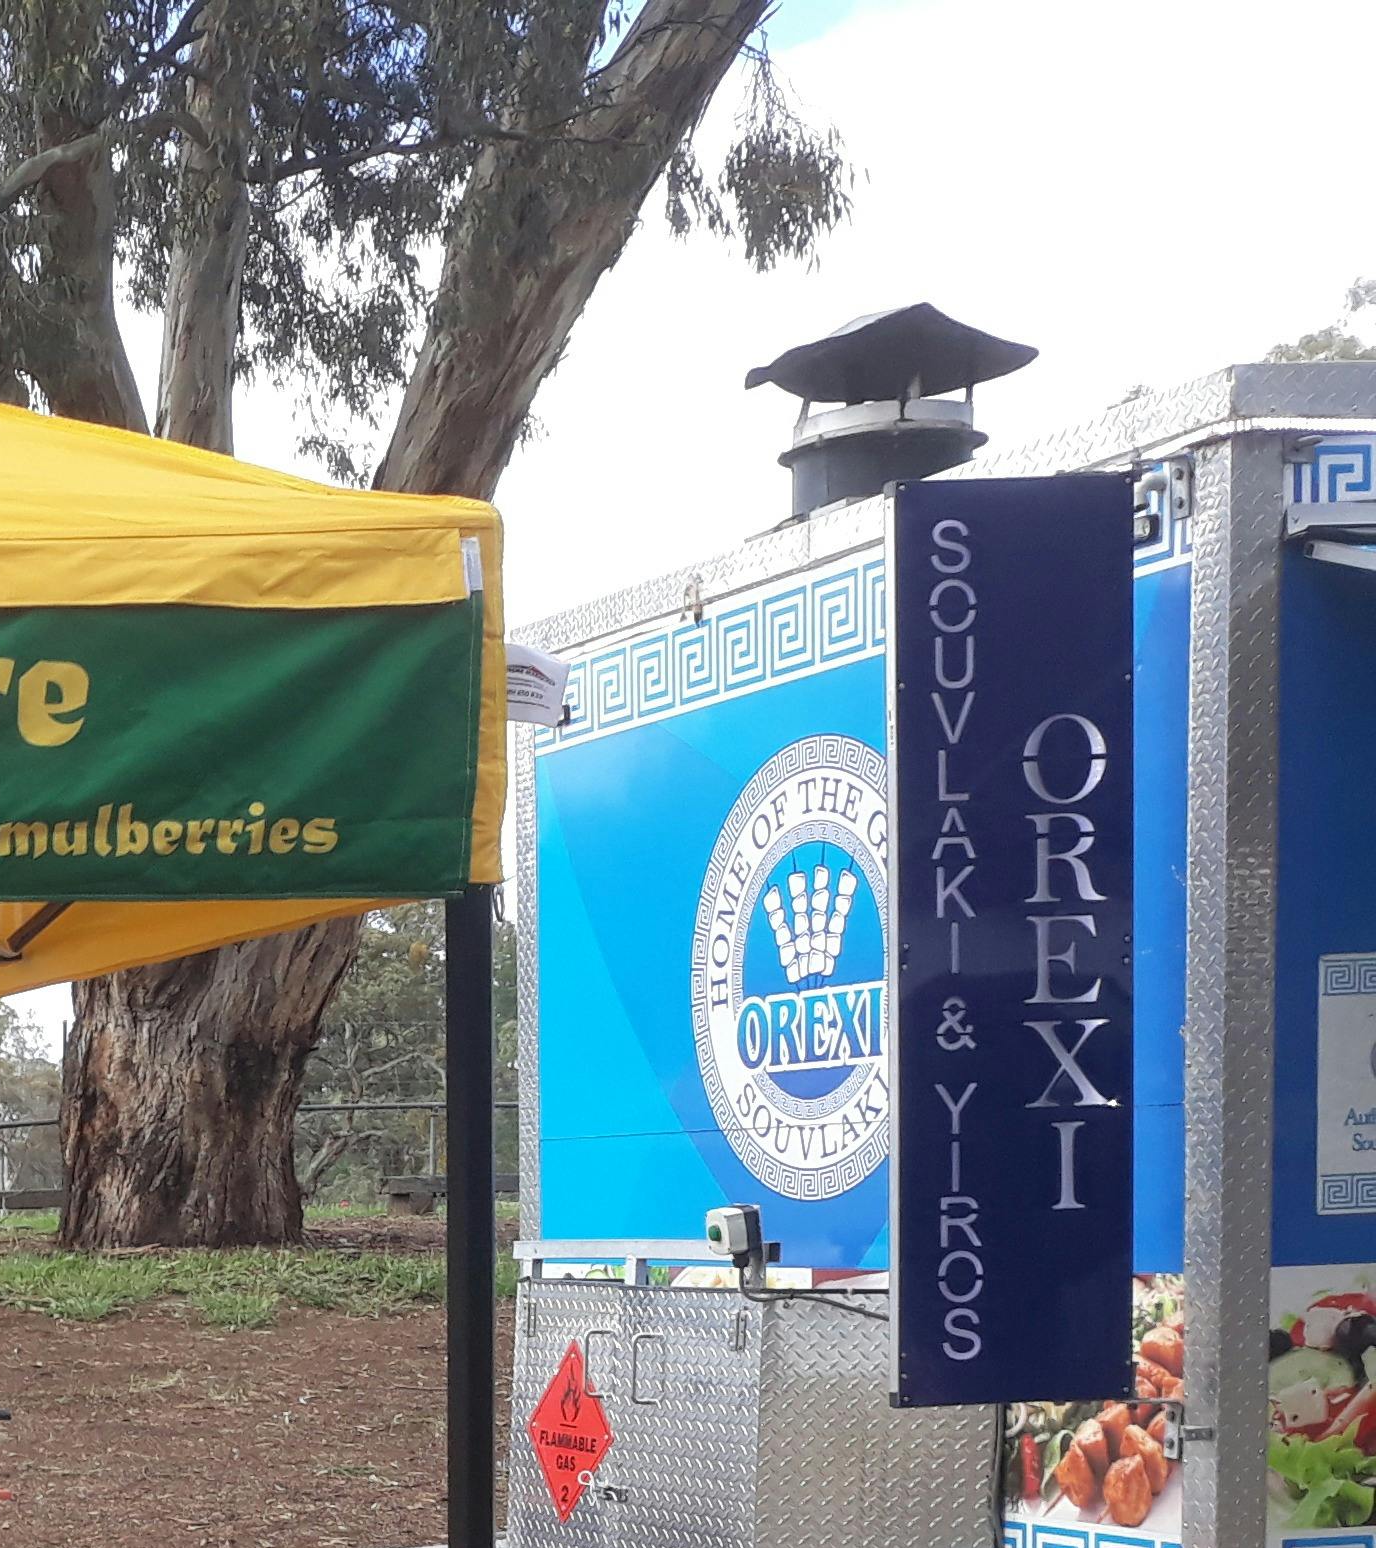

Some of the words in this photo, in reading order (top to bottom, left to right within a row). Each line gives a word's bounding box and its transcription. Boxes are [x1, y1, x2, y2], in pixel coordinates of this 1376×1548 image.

[928, 519, 978, 974] SOUVLAKI
[710, 850, 752, 1013] HOME
[752, 790, 788, 850] OF
[798, 776, 863, 824] THE
[1021, 713, 1113, 1210] OREXI
[736, 987, 884, 1070] OREXI
[935, 997, 978, 1050] &
[735, 1066, 889, 1161] SOUVLAKI
[934, 1082, 984, 1361] YIROS
[539, 1429, 597, 1454] FLAMMABLE
[556, 1453, 576, 1472] GAS
[560, 1485, 570, 1503] 2
